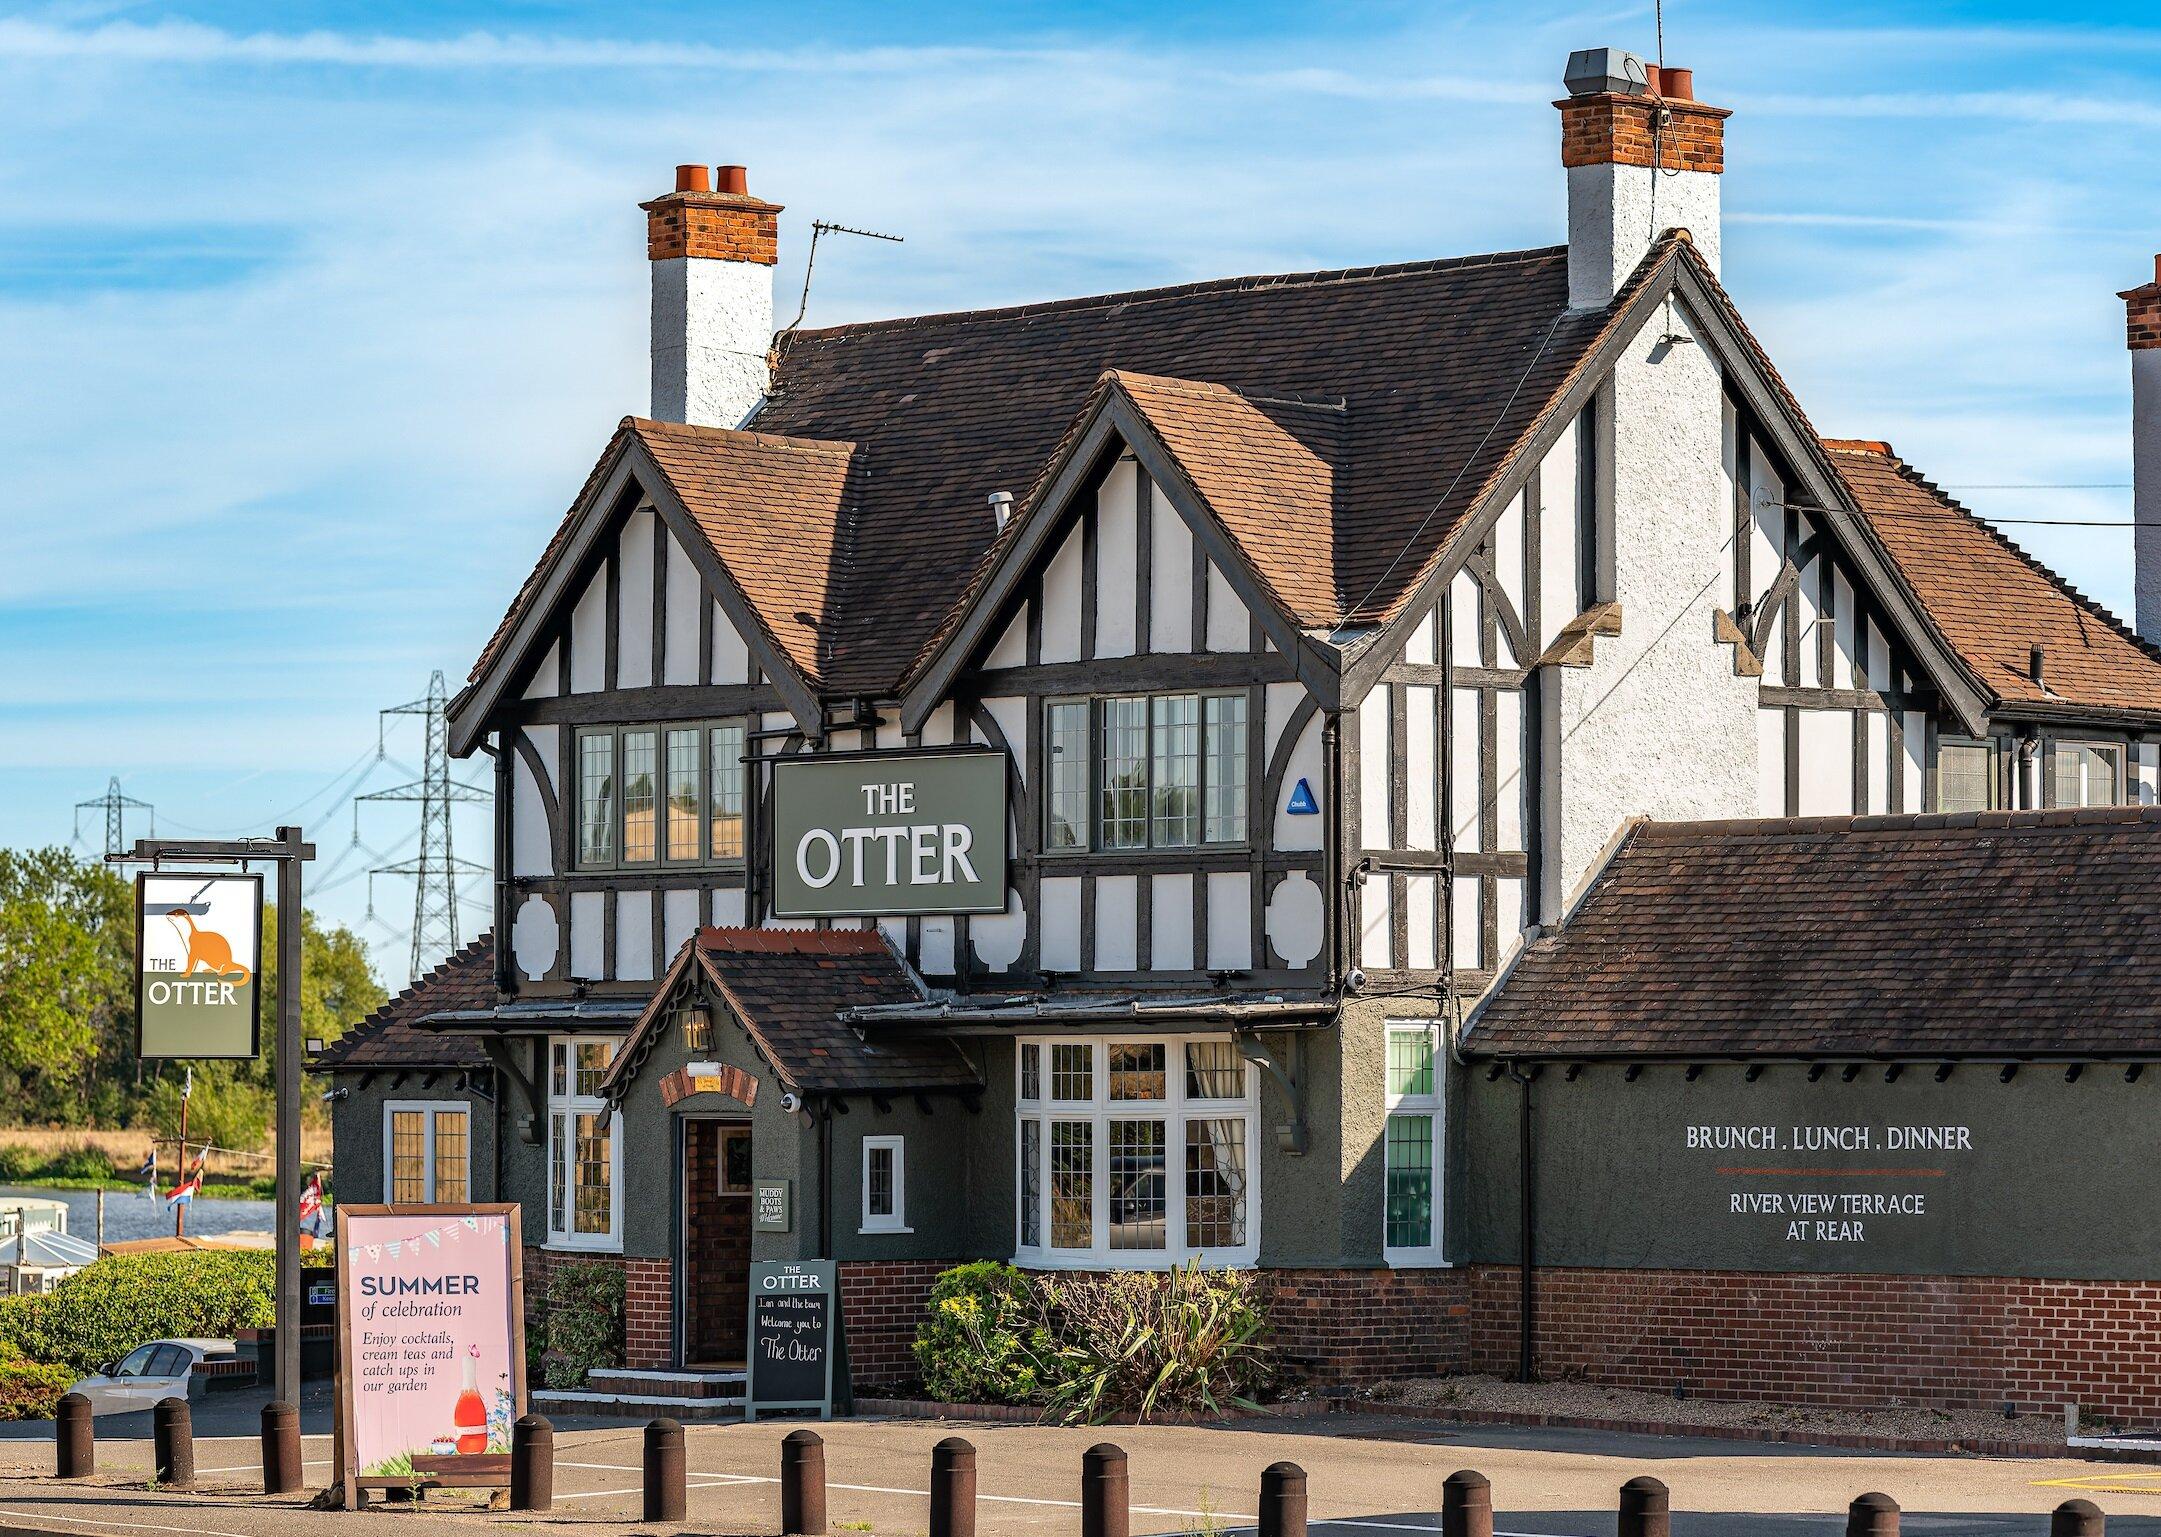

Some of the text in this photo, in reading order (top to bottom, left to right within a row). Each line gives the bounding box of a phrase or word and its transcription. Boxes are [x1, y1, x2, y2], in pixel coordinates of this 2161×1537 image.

[861, 782, 916, 815] THE
[796, 823, 982, 889] OTTER
[149, 958, 176, 971] THE
[148, 981, 238, 1005] OTTER
[1686, 1126, 1777, 1150] BRUNCH
[1793, 1127, 1870, 1151] LUNCH
[1887, 1126, 1974, 1151] DINNER
[759, 1189, 783, 1198] MUDDY
[760, 1197, 782, 1206] BOOTS
[759, 1205, 783, 1214] & PAWS
[1730, 1193, 1925, 1215] RIVER VIEW TERRACE
[1786, 1220, 1865, 1242] AT REAR
[783, 1265, 801, 1274] THE
[361, 1275, 480, 1296] SUMMER
[762, 1274, 821, 1290] OTTER
[361, 1300, 462, 1321] of celebration
[777, 1297, 791, 1308] and
[792, 1297, 804, 1309] the
[761, 1314, 822, 1335] Welcome you to
[362, 1331, 454, 1348] Enjoy cocktails,
[760, 1333, 822, 1362] The Otter
[362, 1347, 454, 1361] cream teas and
[362, 1363, 435, 1378] catch ups in
[363, 1378, 428, 1395] our garden
